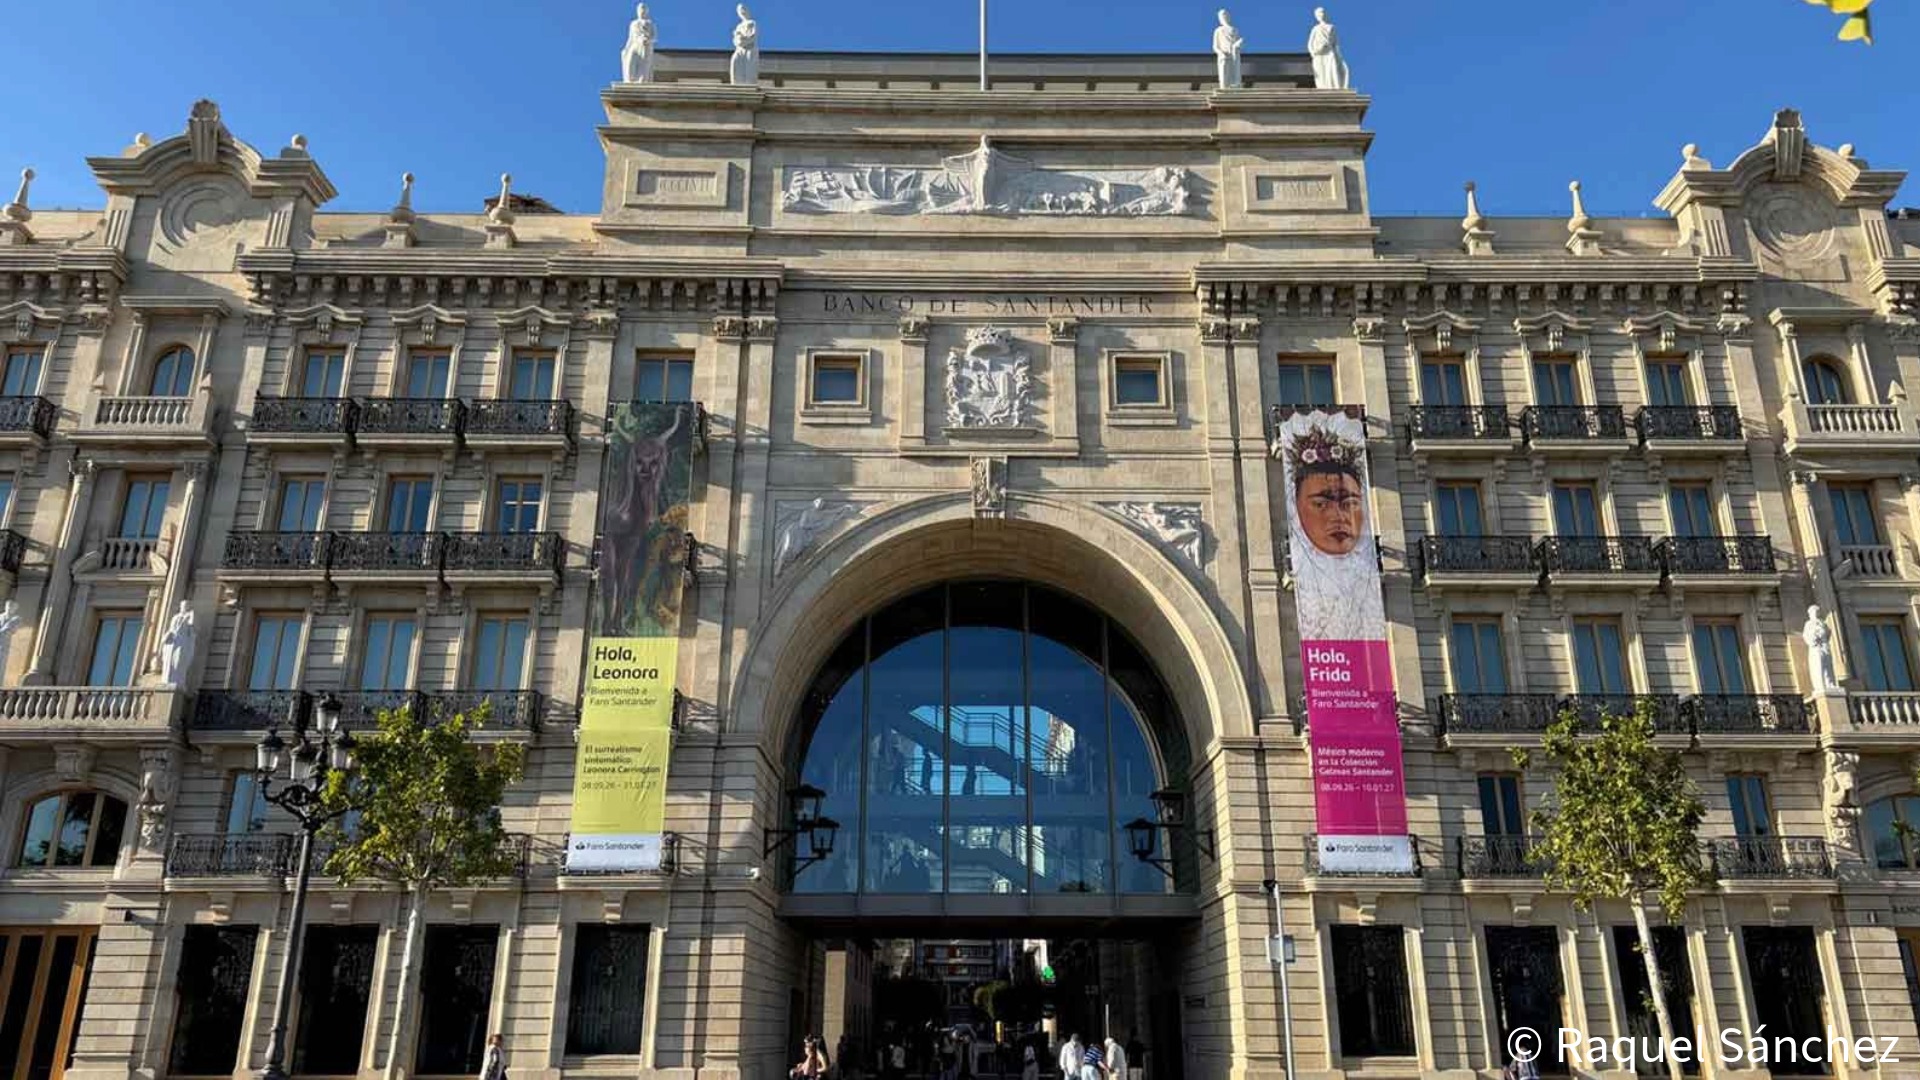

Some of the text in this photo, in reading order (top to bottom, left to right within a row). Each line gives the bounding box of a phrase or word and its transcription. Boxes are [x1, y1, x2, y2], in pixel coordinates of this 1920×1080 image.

[824, 294, 1153, 314] BANCO DE SANTANDER
[595, 646, 636, 663] Hola,
[1307, 648, 1350, 665] Hola,
[593, 665, 658, 679] Leonora
[1309, 667, 1350, 682] Frida
[590, 686, 640, 695] Bienvenida
[1312, 689, 1360, 698] Bienvenida
[1313, 700, 1379, 709] Faro Santander
[585, 745, 593, 753] El
[1349, 748, 1384, 757] moderno
[1352, 767, 1394, 776] Santander
[586, 842, 644, 850] Faro Santander
[1336, 844, 1393, 852] Faro Santander
